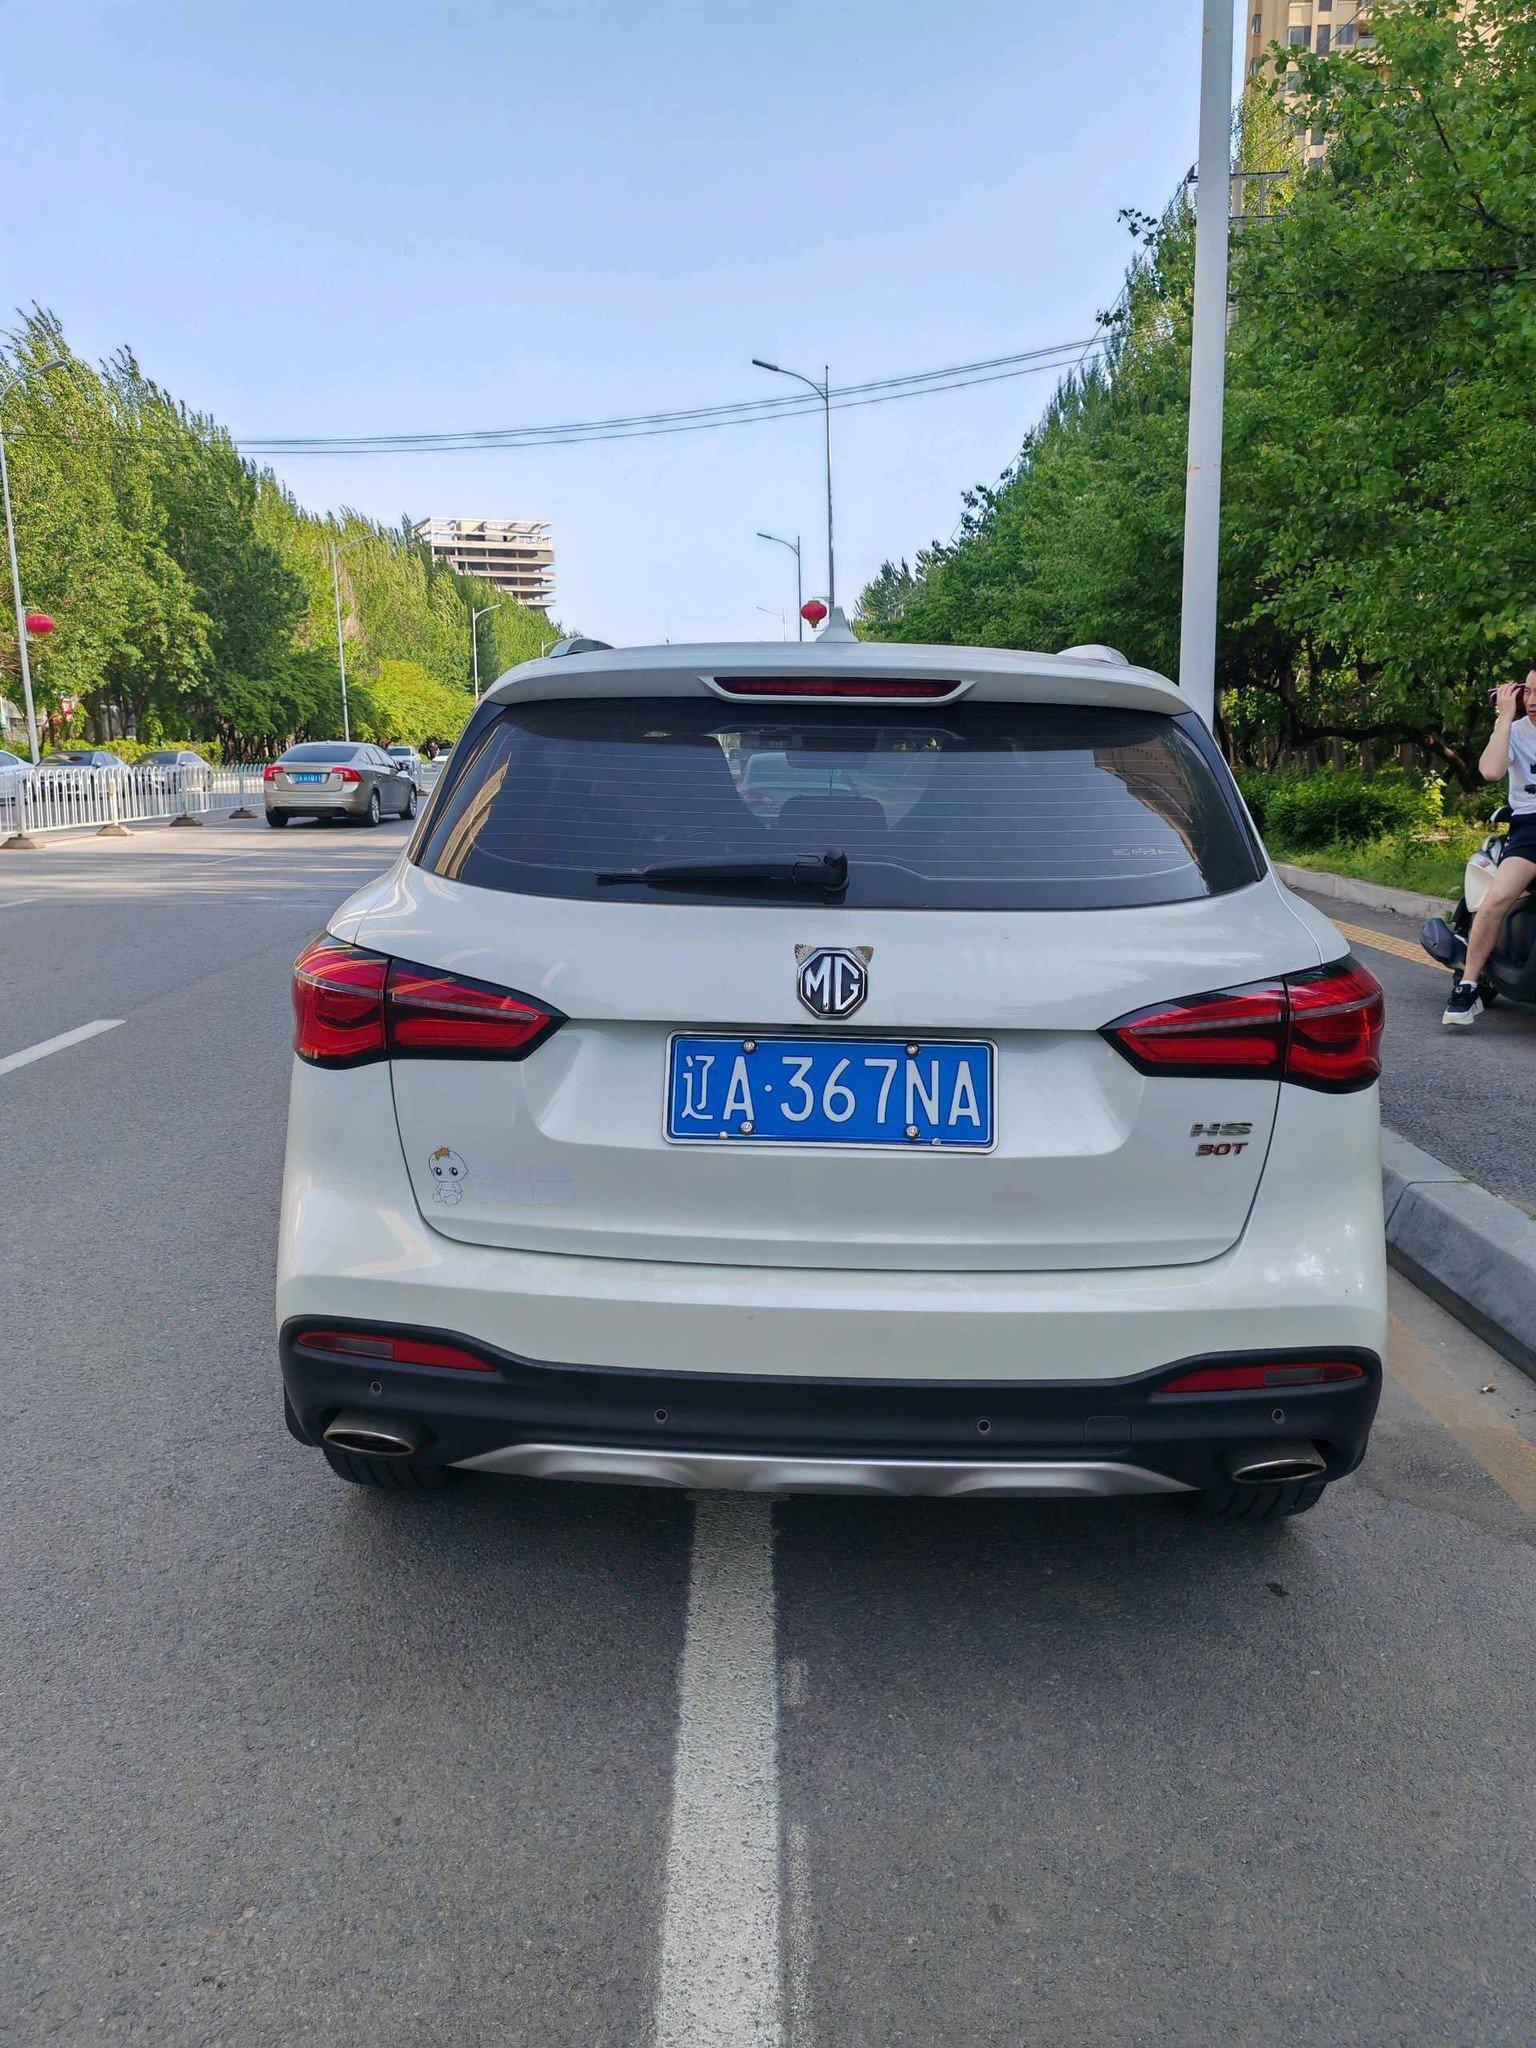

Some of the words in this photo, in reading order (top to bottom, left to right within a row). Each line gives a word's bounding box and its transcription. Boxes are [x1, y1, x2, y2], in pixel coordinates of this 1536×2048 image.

[804, 956, 861, 1011] MG
[681, 1055, 981, 1127] 辽A·367NA
[1190, 1122, 1253, 1137] HS
[1196, 1142, 1249, 1156] 30T
